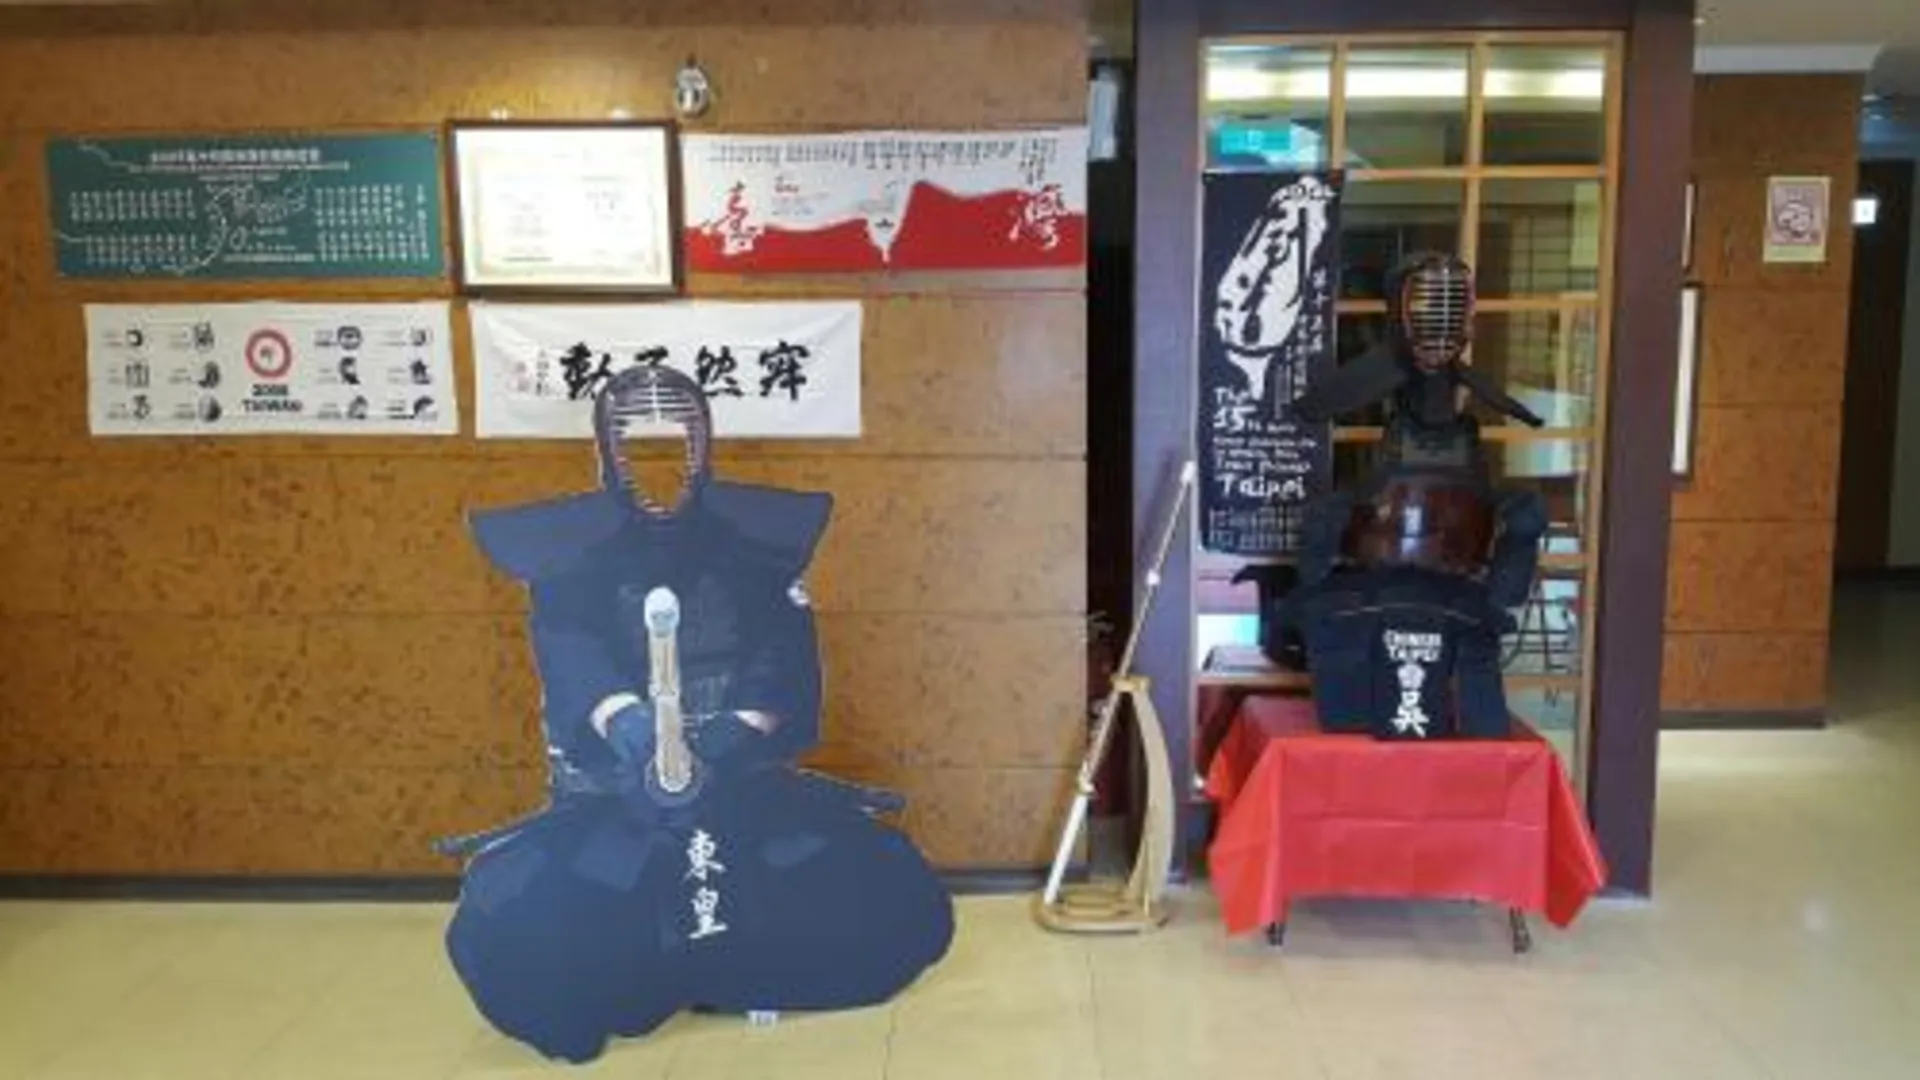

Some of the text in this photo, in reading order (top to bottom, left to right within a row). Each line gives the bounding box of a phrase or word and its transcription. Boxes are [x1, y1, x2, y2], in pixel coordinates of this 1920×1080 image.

[241, 398, 304, 412] TAIWAN
[1213, 472, 1306, 503] Taipei
[1388, 646, 1440, 662] TAIPEI
